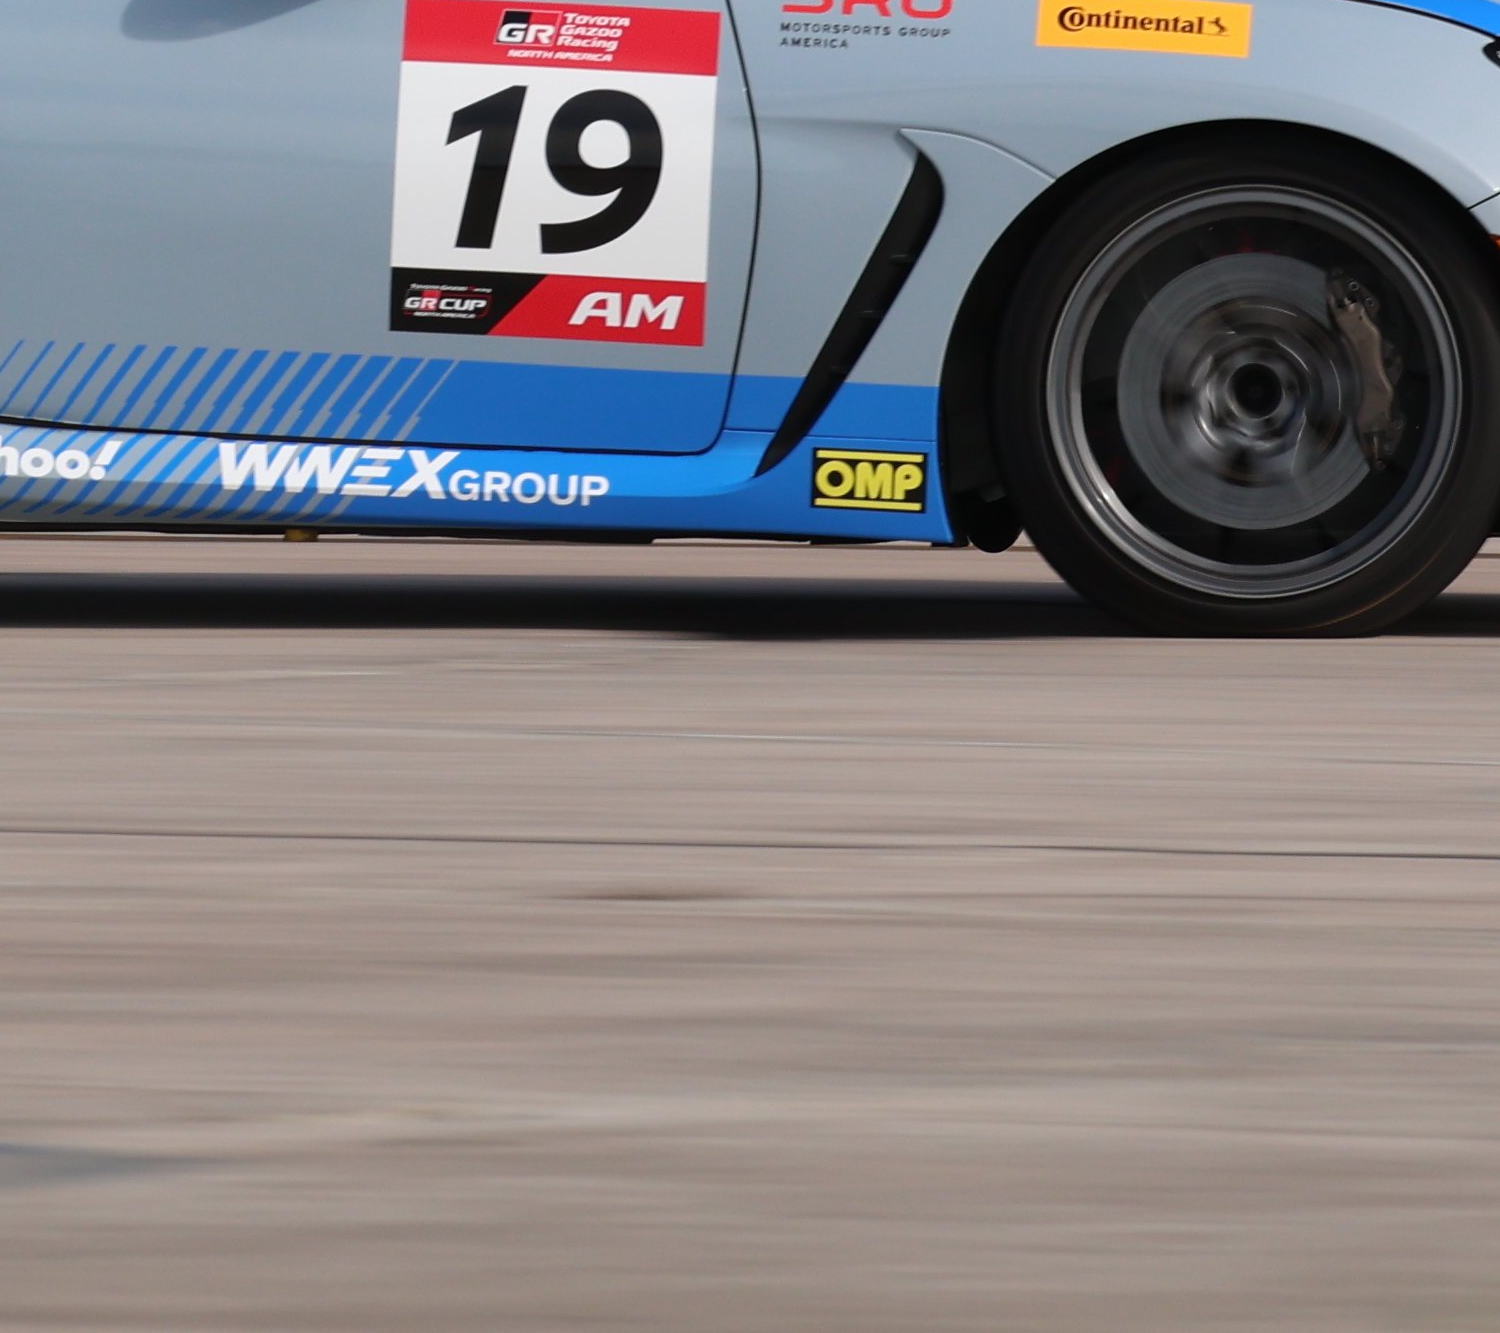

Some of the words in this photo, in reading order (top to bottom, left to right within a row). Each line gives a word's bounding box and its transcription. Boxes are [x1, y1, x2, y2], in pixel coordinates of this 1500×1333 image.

[563, 12, 632, 27] TOYOTA
[1057, 5, 1205, 35] Continental
[497, 22, 556, 44] GR
[559, 24, 624, 38] GAZOO
[779, 21, 892, 37] MOTORSPORTS
[897, 26, 952, 38] GROUP
[556, 35, 619, 52] Racing
[779, 36, 849, 50] AMERICA
[553, 50, 614, 63] AMERICA
[444, 84, 665, 255] 19
[403, 296, 439, 311] GR
[438, 297, 488, 312] CUP
[567, 289, 685, 331] AM
[817, 461, 924, 500] OMP
